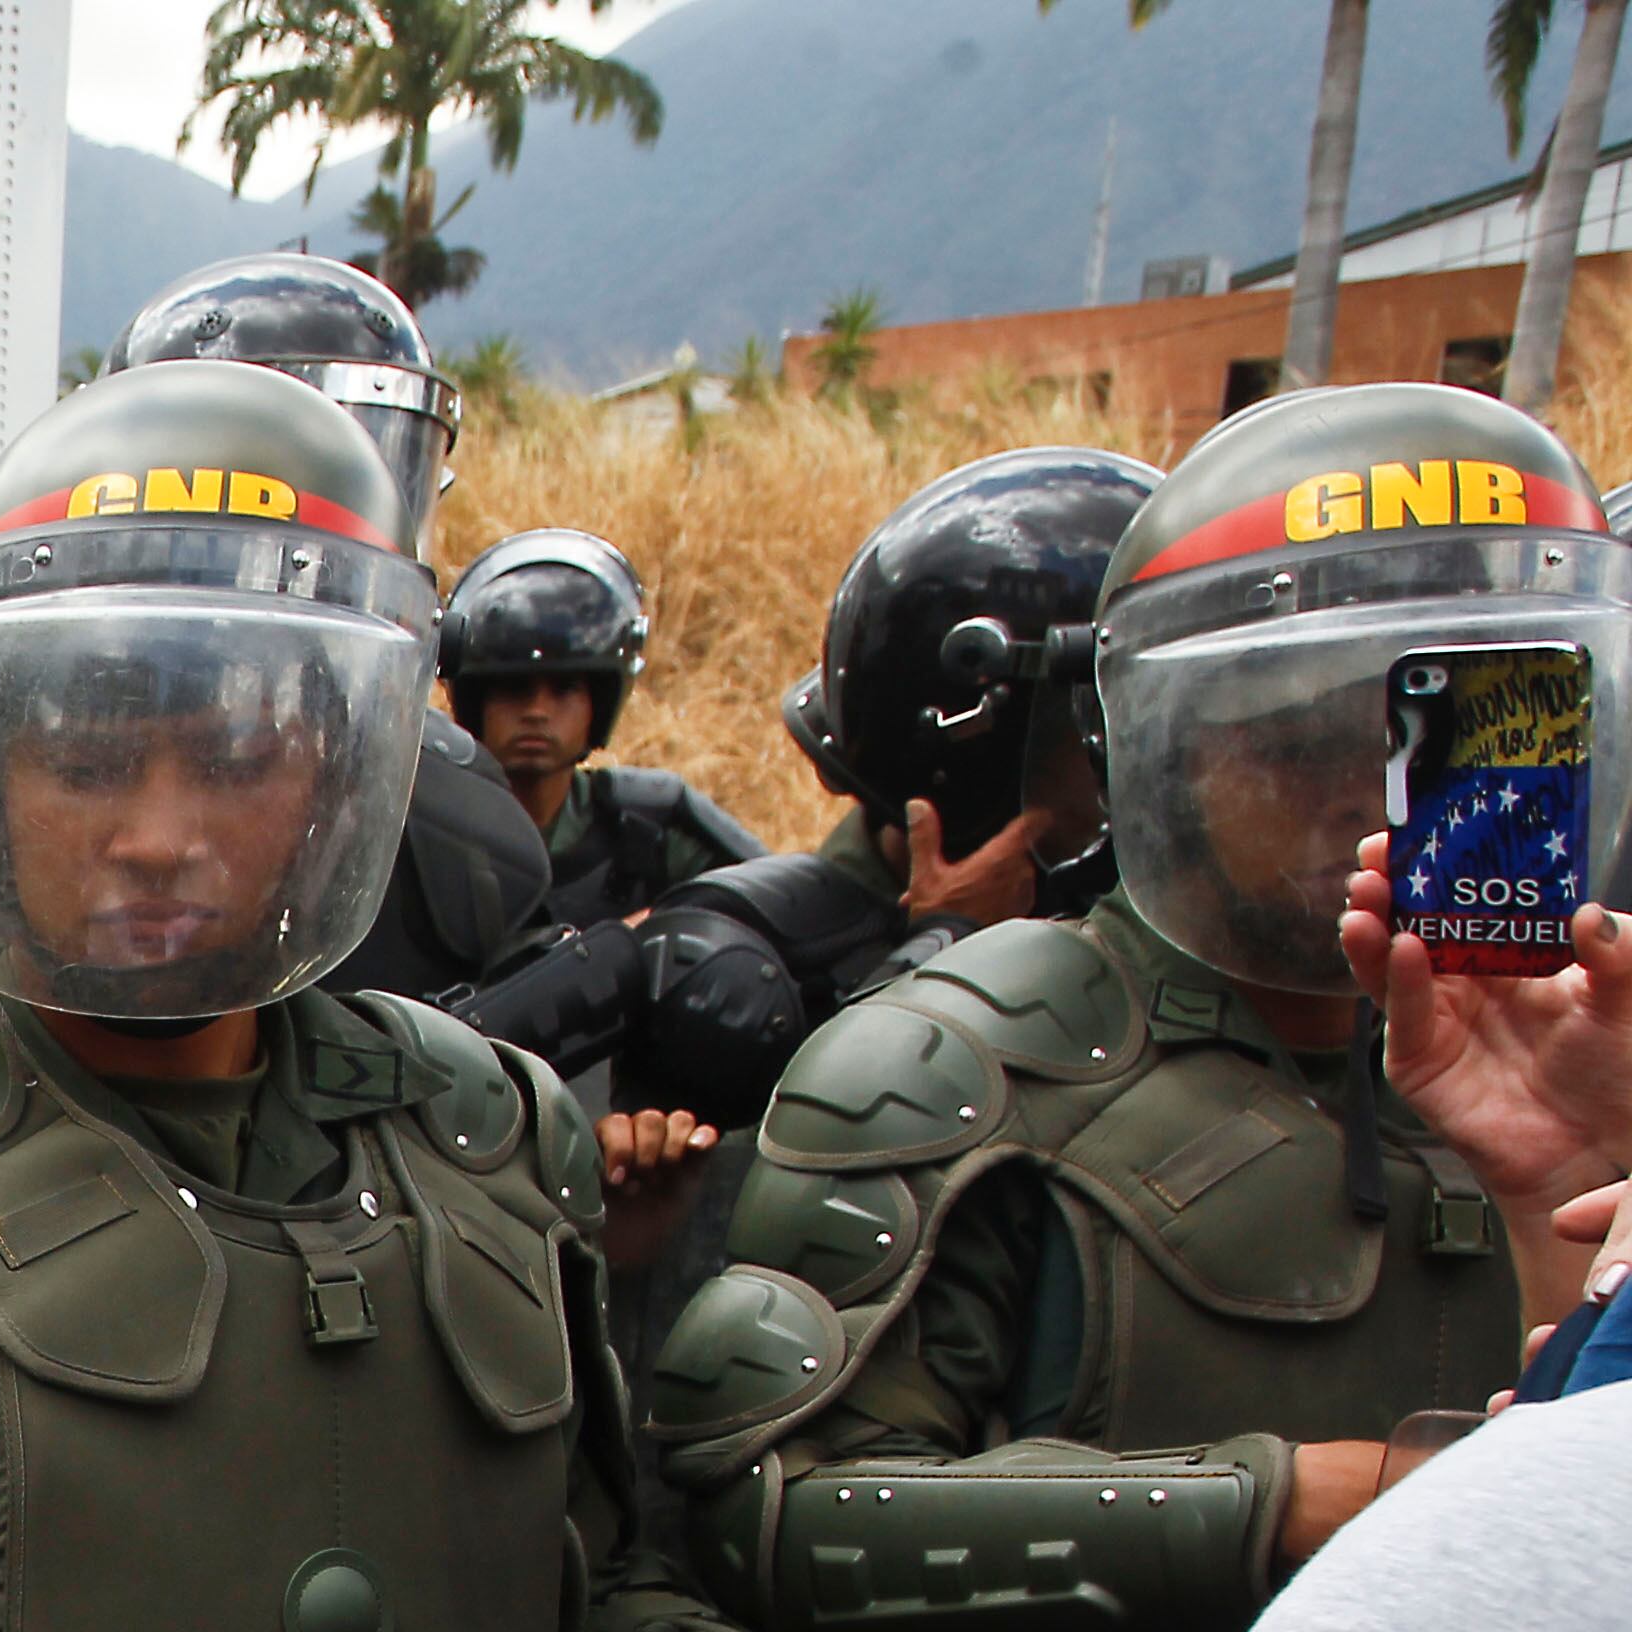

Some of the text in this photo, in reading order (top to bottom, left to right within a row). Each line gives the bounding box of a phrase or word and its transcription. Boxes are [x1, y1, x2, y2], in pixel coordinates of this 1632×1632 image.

[1283, 458, 1529, 543] GNB
[1452, 878, 1541, 907] SOS
[1396, 917, 1571, 944] VENEZUEL
